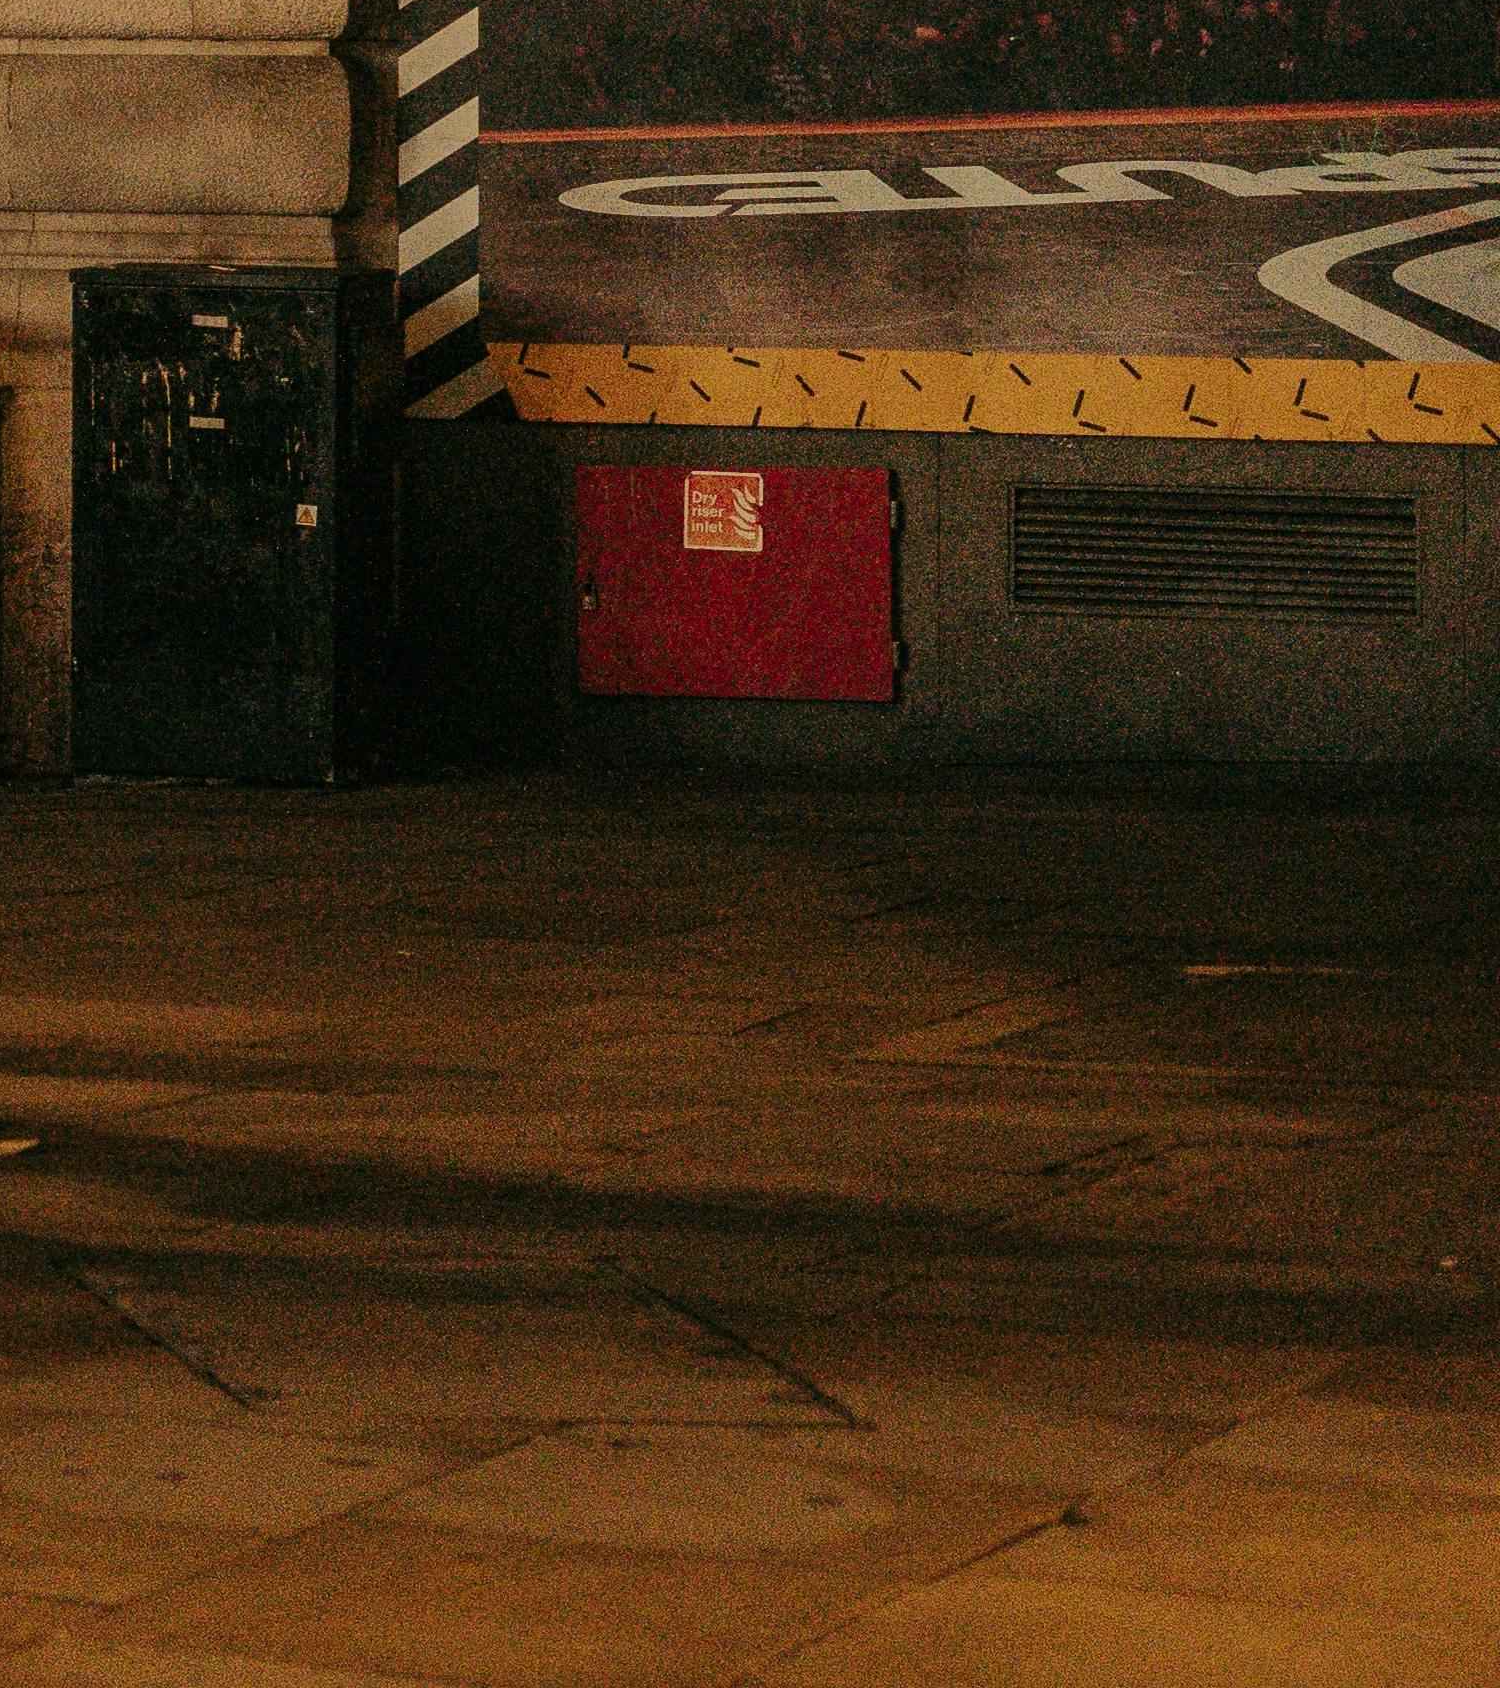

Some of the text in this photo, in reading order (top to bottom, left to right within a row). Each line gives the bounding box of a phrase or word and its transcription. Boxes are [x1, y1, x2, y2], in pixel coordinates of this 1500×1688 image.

[691, 491, 717, 506] Dry
[691, 507, 725, 518] riser
[691, 520, 724, 533] inlet
